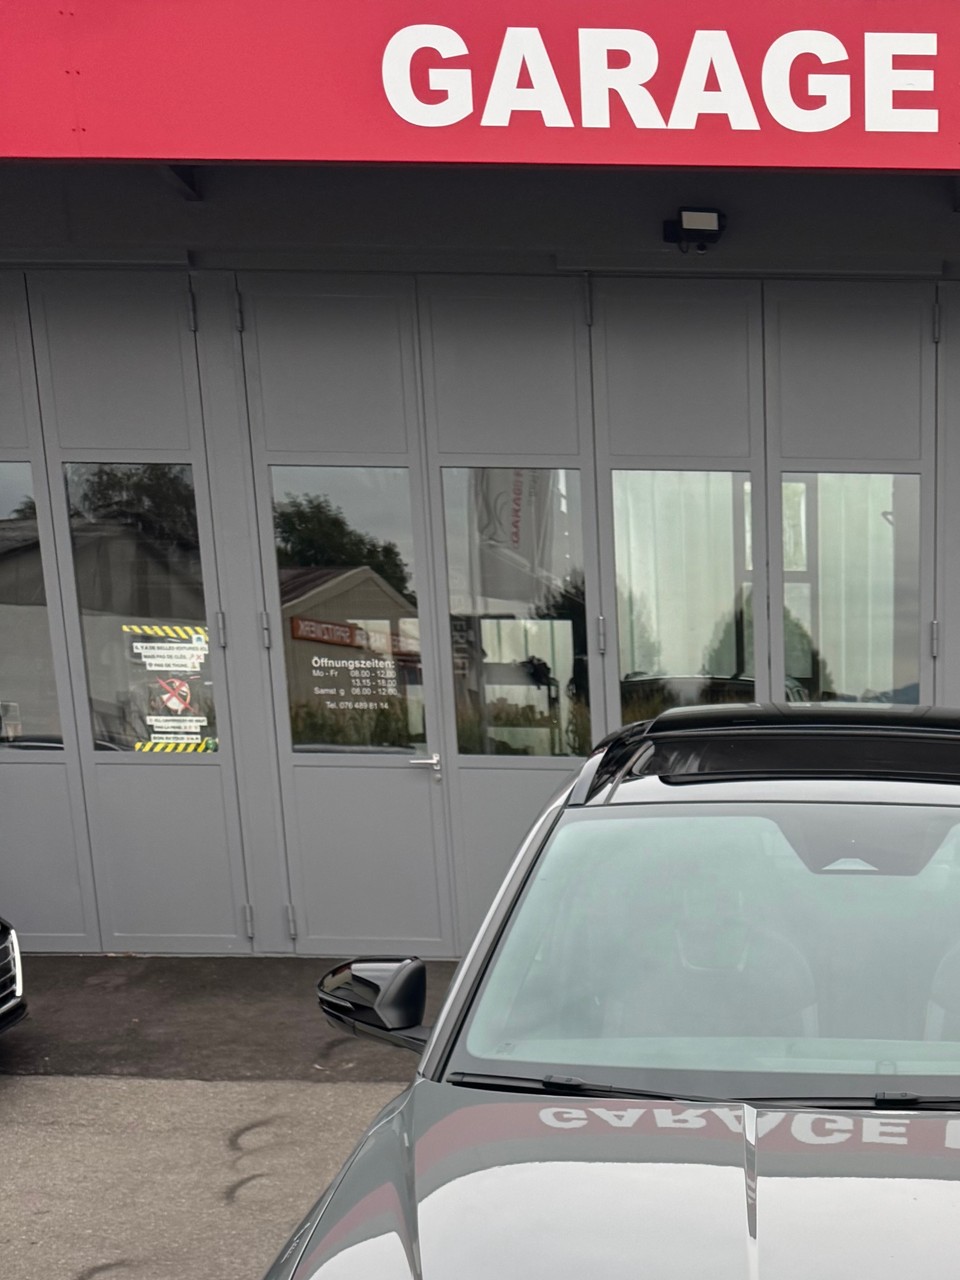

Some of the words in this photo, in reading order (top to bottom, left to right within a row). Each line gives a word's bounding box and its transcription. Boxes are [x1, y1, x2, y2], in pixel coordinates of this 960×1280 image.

[381, 24, 941, 133] GARAGE
[311, 656, 396, 669] Öffnungszeiten:
[312, 669, 324, 677] Mo
[330, 669, 339, 677] Fr
